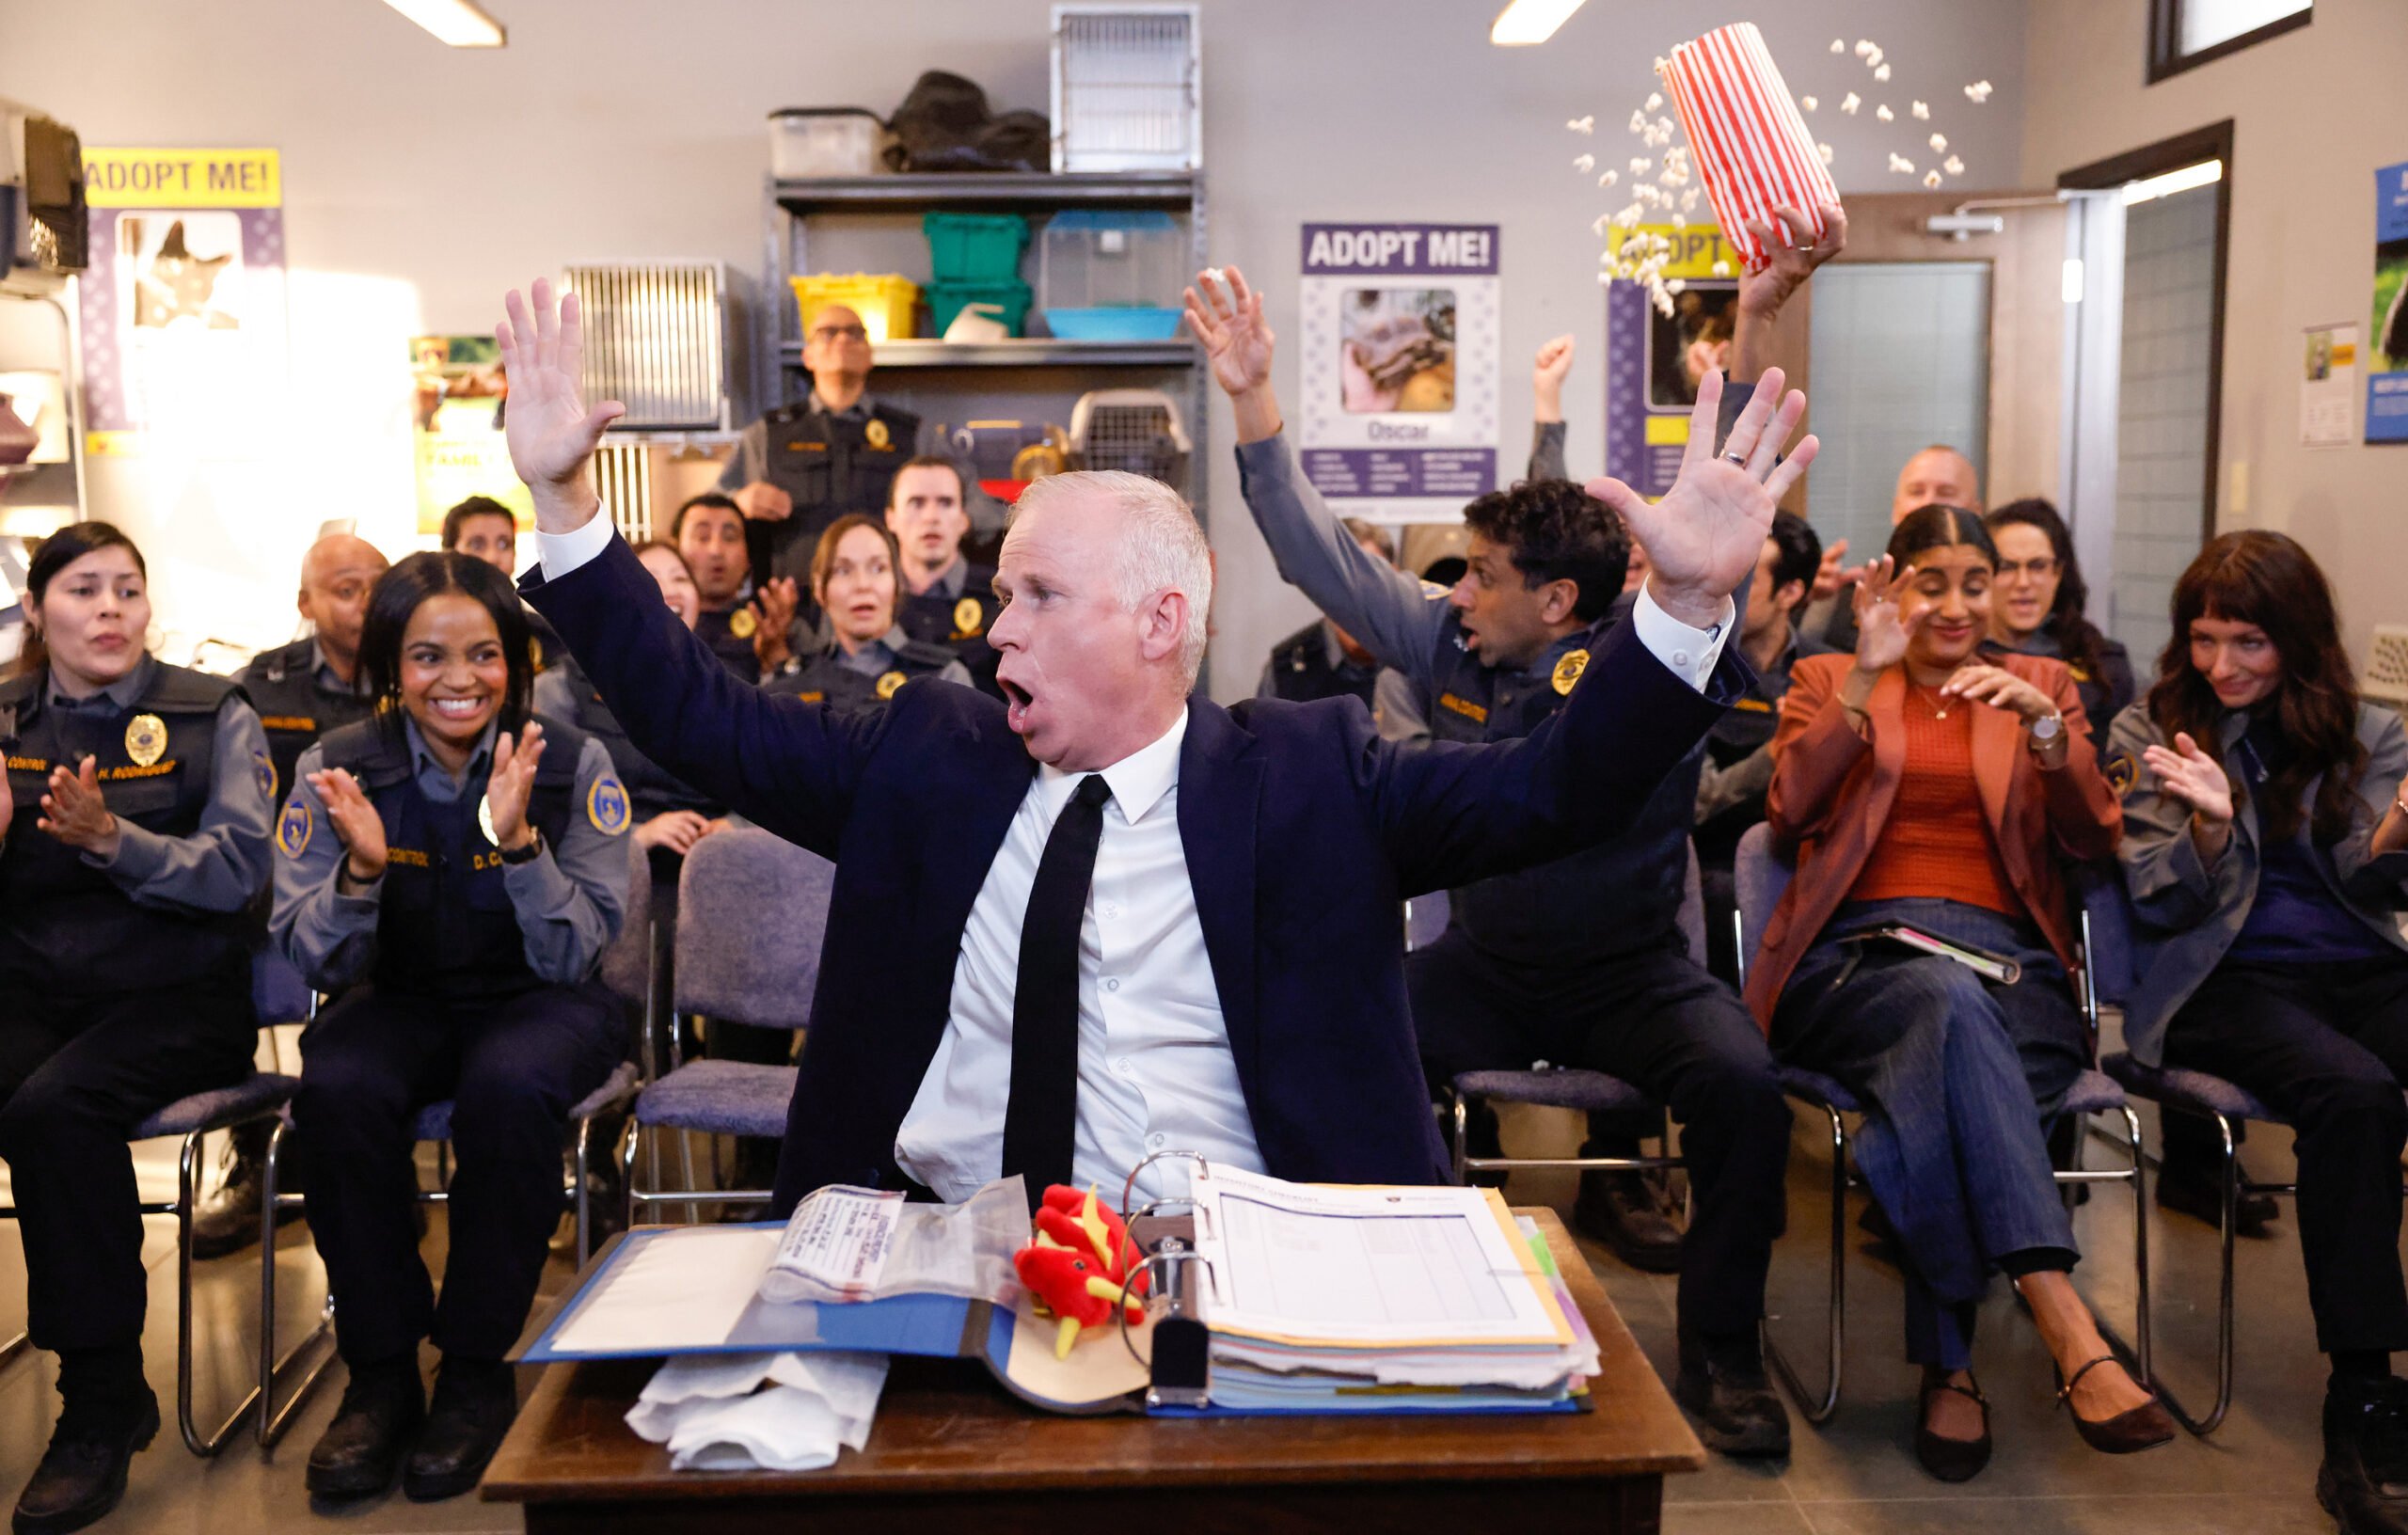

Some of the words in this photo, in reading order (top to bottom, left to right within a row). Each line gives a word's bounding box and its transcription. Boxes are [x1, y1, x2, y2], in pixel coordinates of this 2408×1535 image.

[84, 161, 194, 192] ADOPT
[208, 162, 268, 193] ME!
[1307, 230, 1421, 267] ADOPT
[1427, 230, 1490, 267] ME!
[1368, 421, 1430, 441] Oscar
[473, 854, 488, 870] D.
